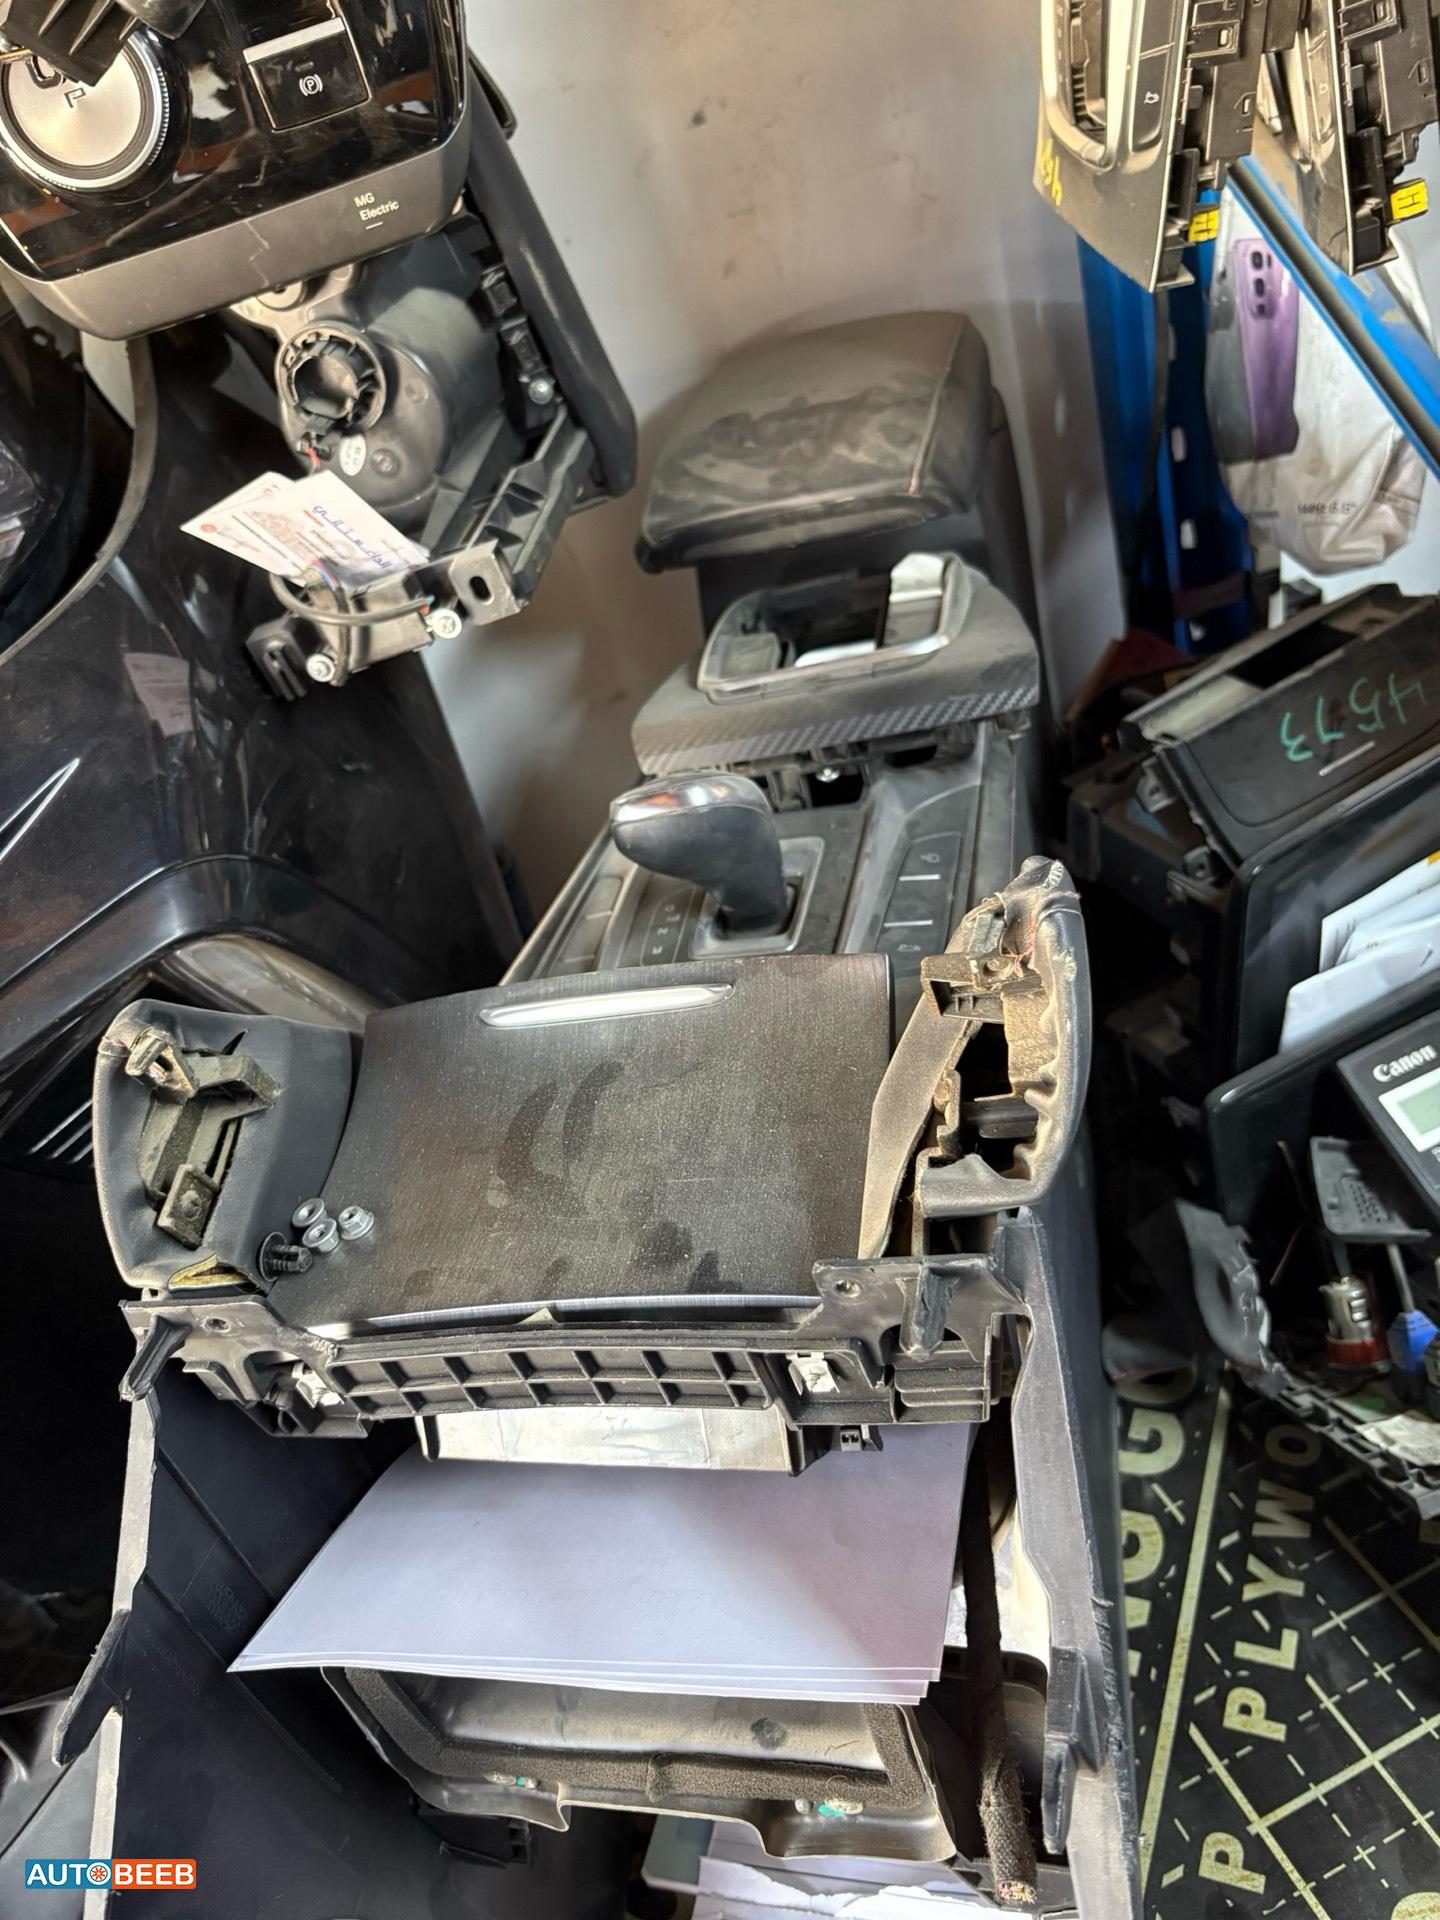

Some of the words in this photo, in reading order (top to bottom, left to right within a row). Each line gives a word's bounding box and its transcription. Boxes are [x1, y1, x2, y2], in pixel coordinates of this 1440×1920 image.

[64, 87, 86, 108] P
[354, 192, 375, 207] MG
[359, 201, 400, 221] Electric
[1279, 673, 1429, 763] 4573
[1371, 1043, 1438, 1083] Canon
